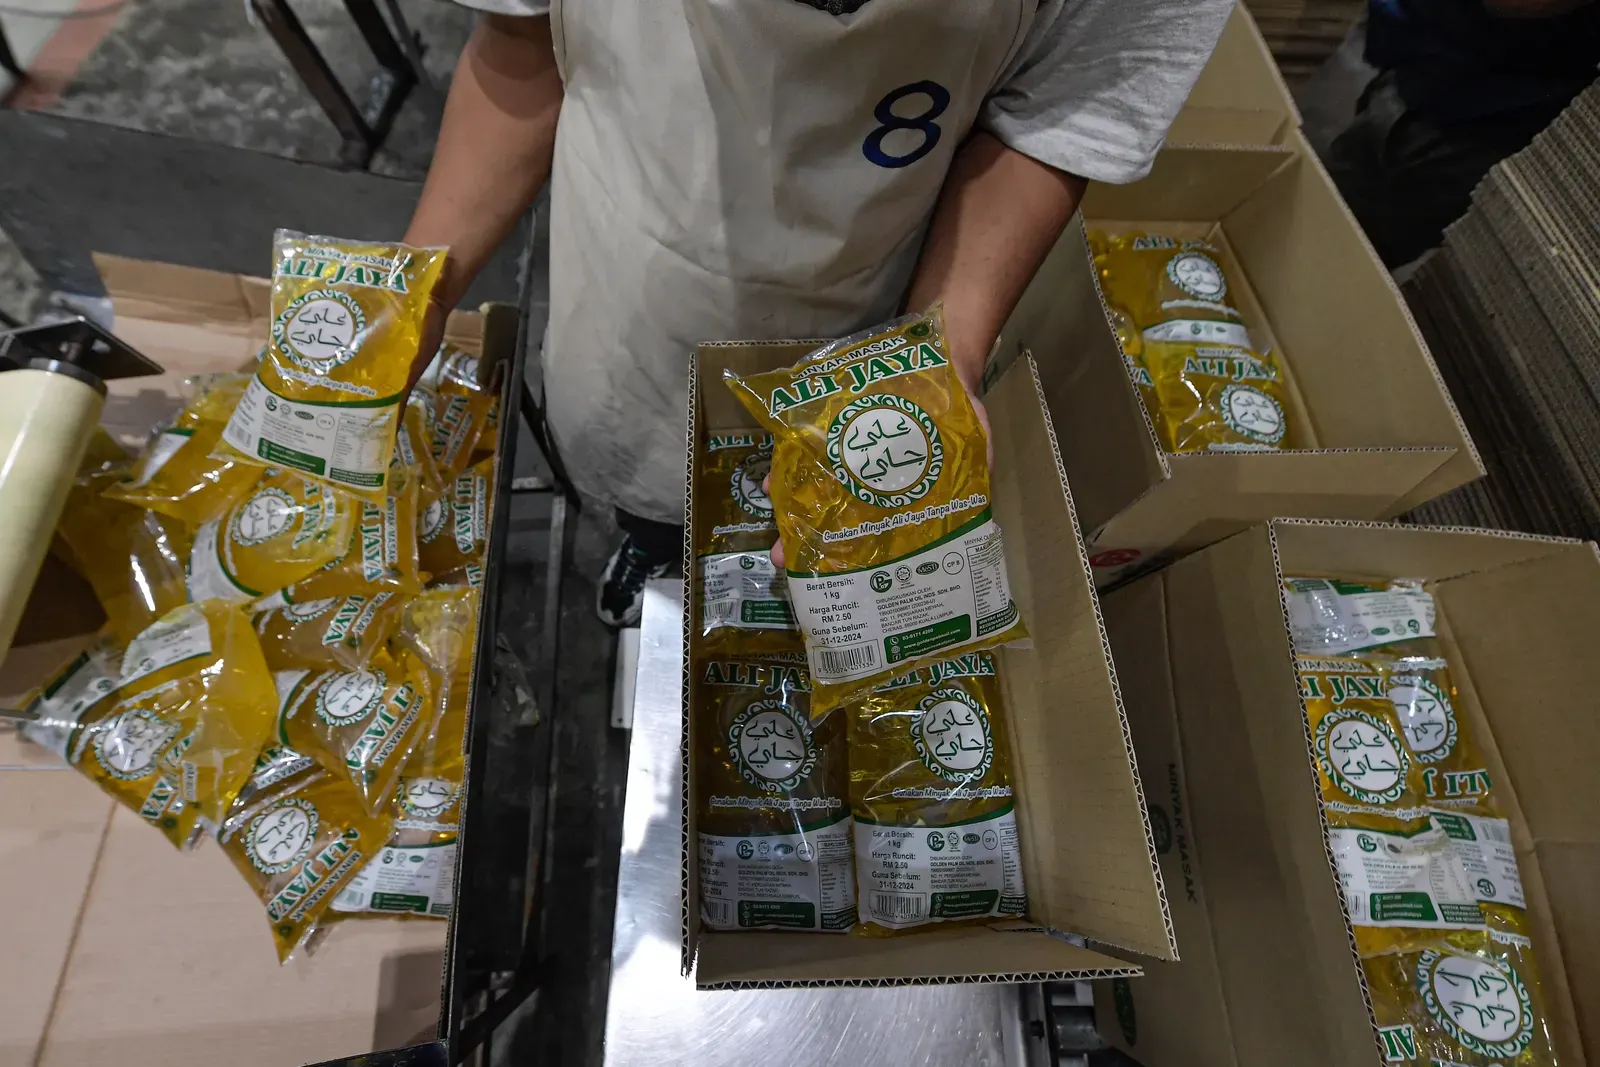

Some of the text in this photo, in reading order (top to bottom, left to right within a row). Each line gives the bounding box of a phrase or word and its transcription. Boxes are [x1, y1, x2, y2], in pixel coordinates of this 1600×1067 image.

[862, 80, 950, 168] 8
[848, 336, 907, 360] MASAK
[770, 342, 948, 418] ALI JAYA
[1183, 356, 1228, 379] ALI
[452, 501, 476, 555] JAYA
[824, 494, 987, 543] Gunakan Minyak Ali Jaya Tanpa Was-Was
[359, 524, 385, 583] JAYA
[806, 578, 855, 592] Berat Bersih:
[830, 591, 840, 600] kg
[808, 601, 860, 615] Harga Runcit:
[822, 612, 852, 624] RM 2.50
[877, 601, 900, 611] GOLDEN
[900, 598, 914, 607] PALM
[811, 622, 869, 636] Guna Sebelum:
[820, 632, 862, 645] 31-12-2024
[704, 661, 761, 687] ALI
[928, 654, 996, 688] JAYA
[1326, 676, 1389, 704] JAY
[372, 694, 425, 767] MINYAK MASAK
[892, 840, 901, 849] kg
[1168, 763, 1198, 904] MINYAK MASAK
[892, 852, 916, 860] Runcit:
[321, 850, 362, 890] MINYAK
[266, 860, 324, 924] JAYA
[288, 887, 323, 923] MASAK
